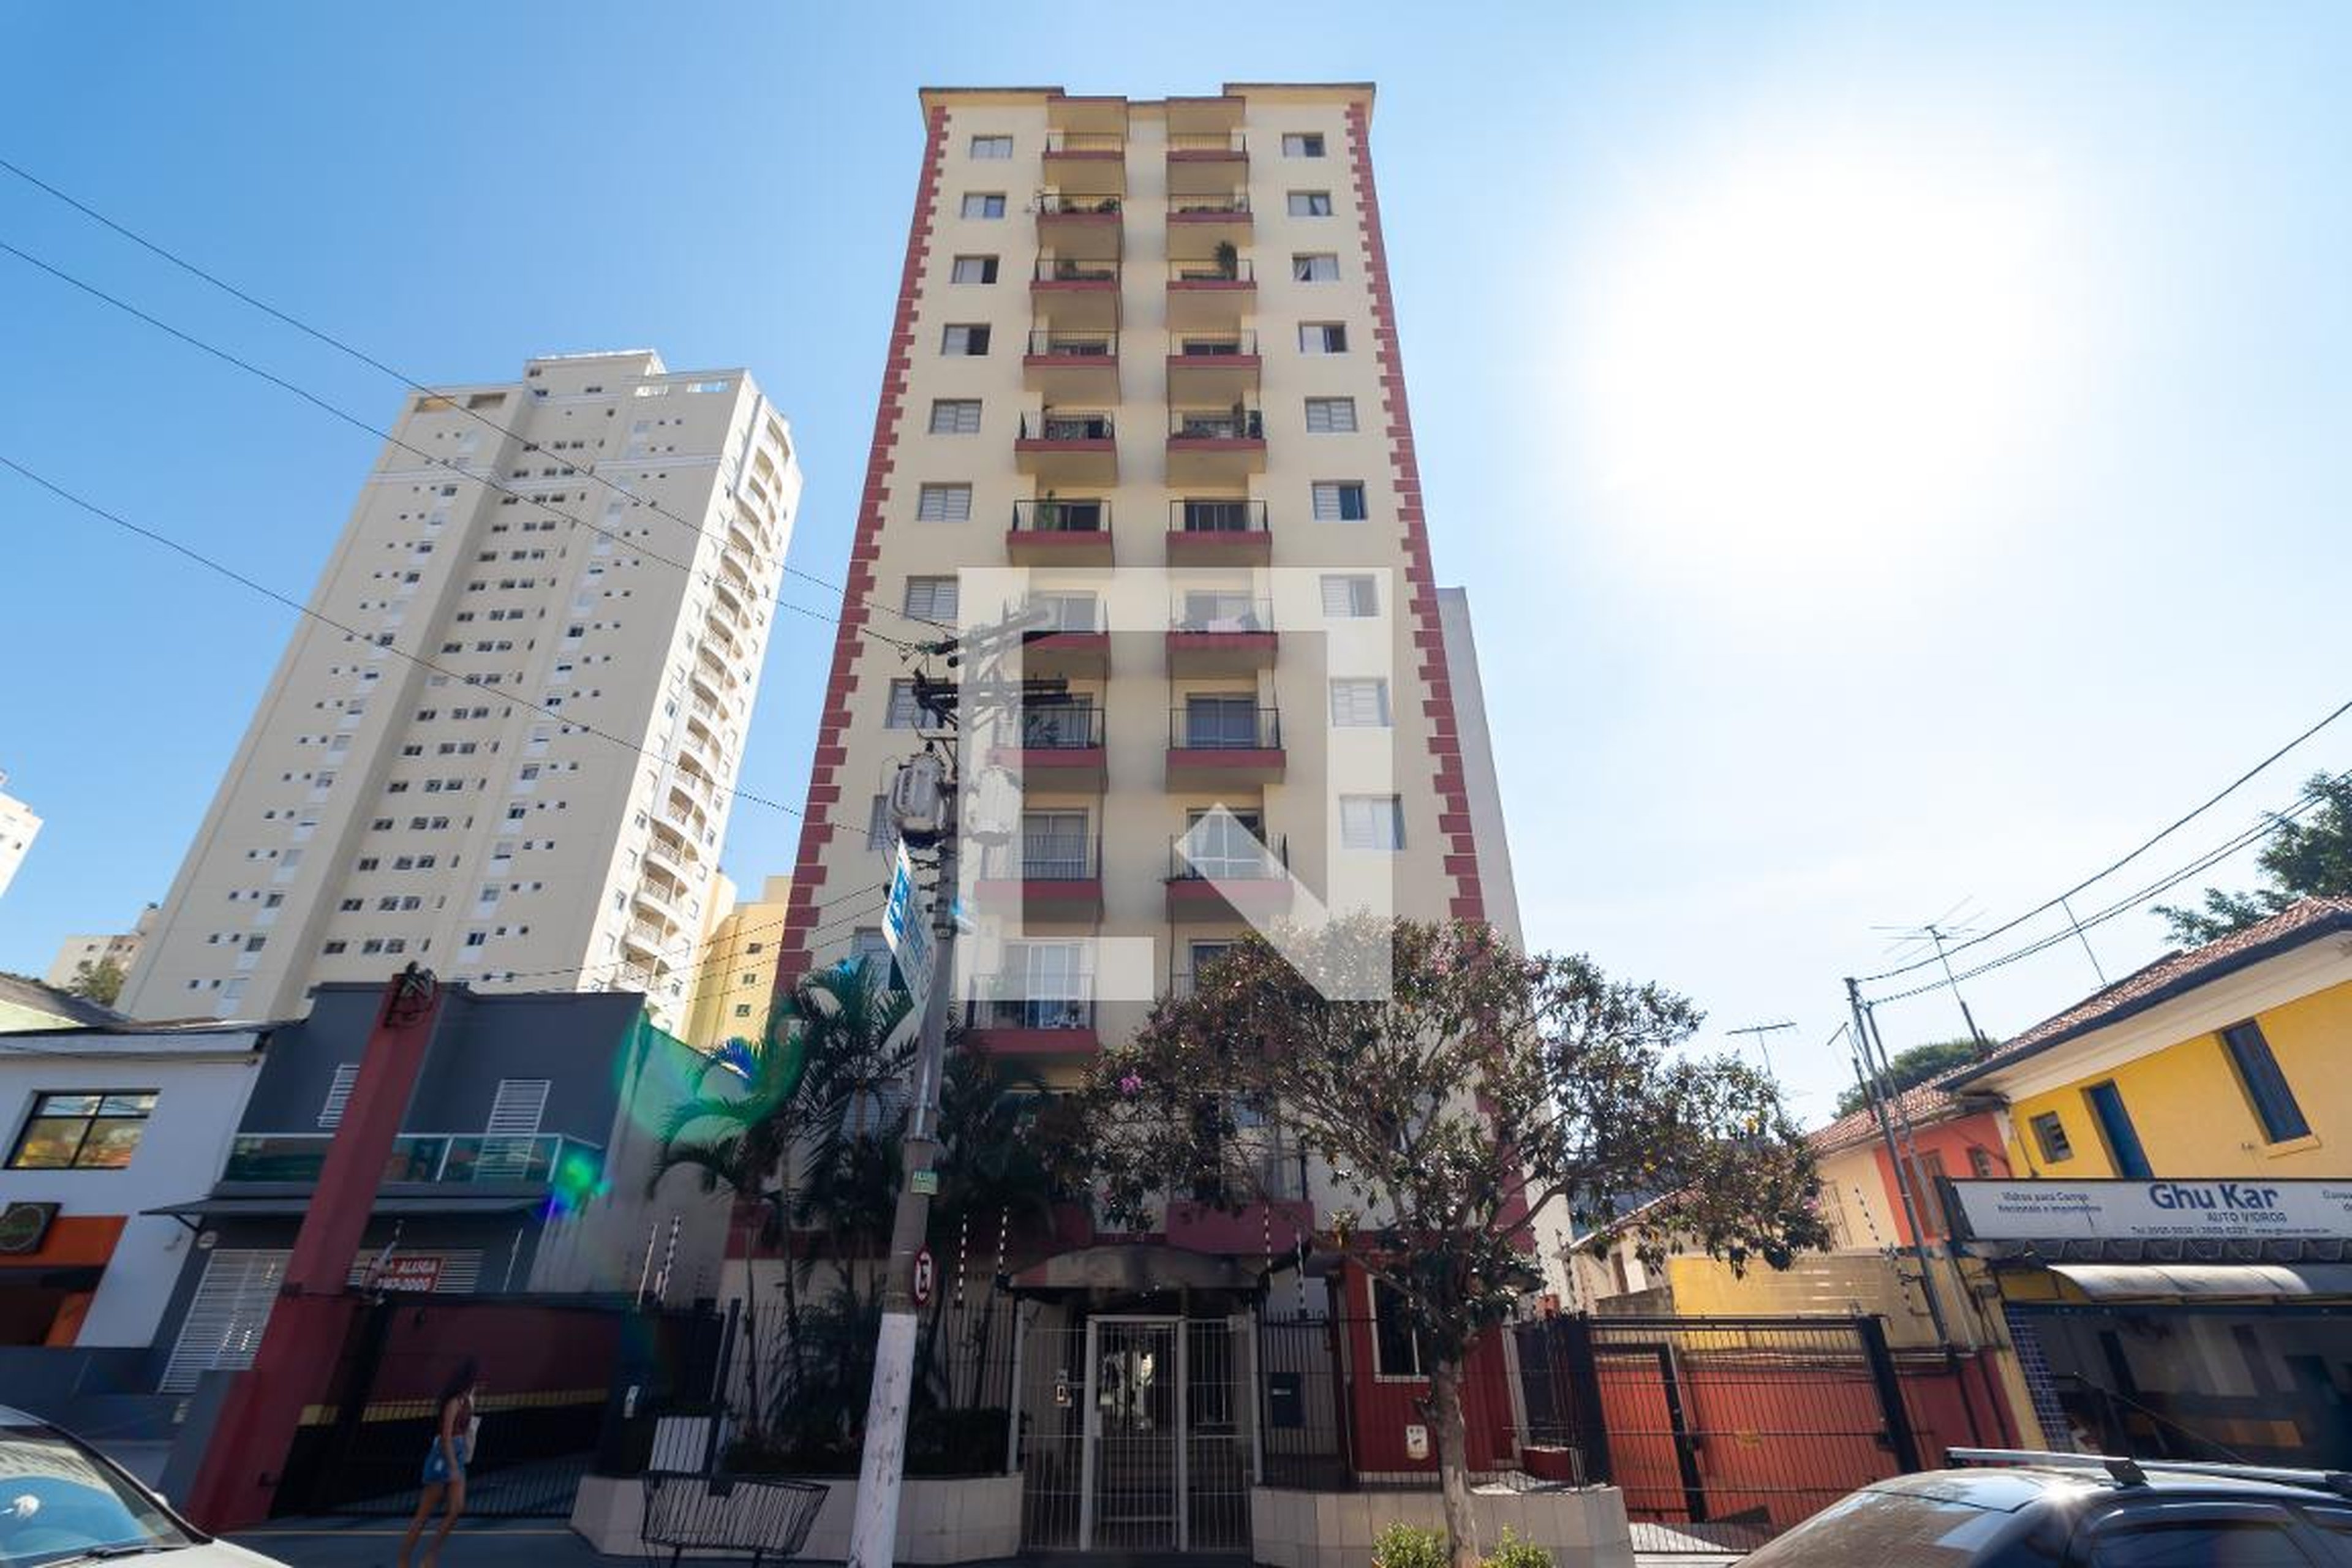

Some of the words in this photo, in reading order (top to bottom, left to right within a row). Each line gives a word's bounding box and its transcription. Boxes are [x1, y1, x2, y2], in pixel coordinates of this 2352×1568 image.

[2149, 1183, 2216, 1210] Ghu
[2218, 1183, 2279, 1210] Kar
[2207, 1212, 2239, 1223] AUTO
[2241, 1212, 2287, 1223] VIDROS
